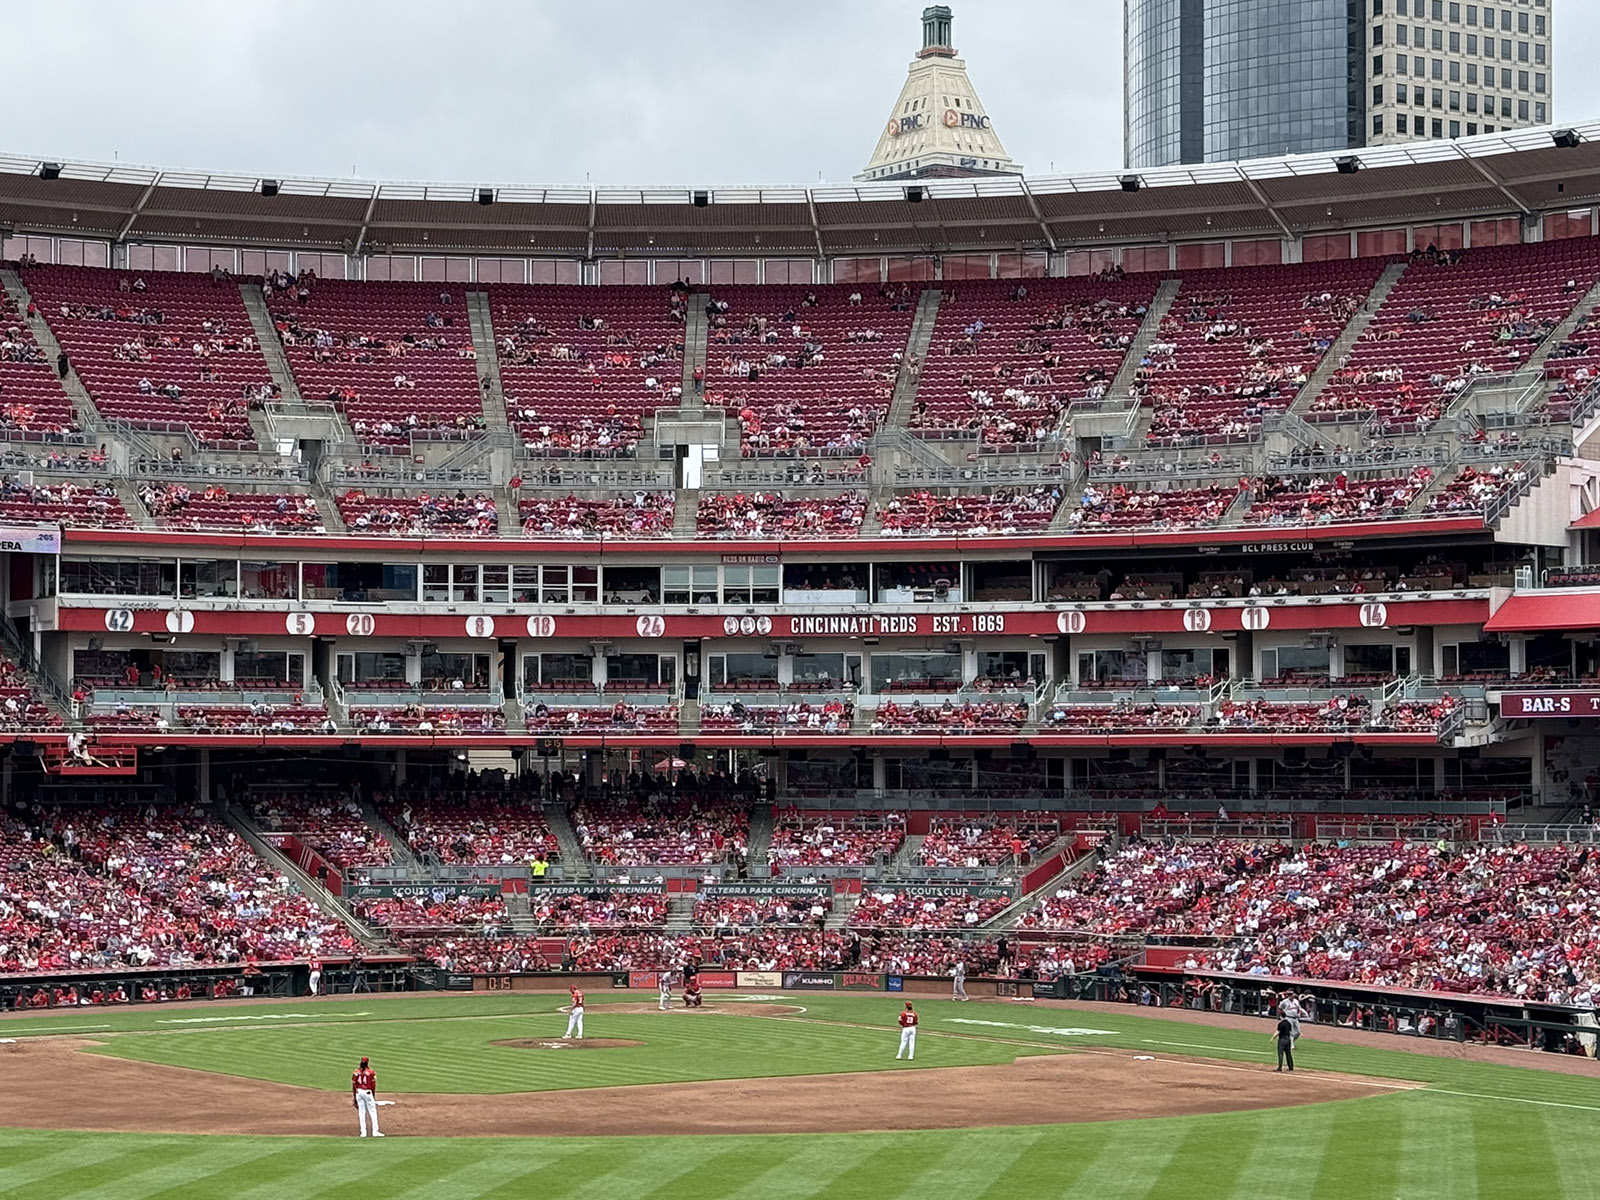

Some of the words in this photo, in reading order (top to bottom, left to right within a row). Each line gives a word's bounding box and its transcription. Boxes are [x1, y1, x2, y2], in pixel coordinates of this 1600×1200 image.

[900, 113, 923, 132] PNC
[960, 112, 990, 129] PNC
[0, 541, 22, 551] ERA
[1242, 544, 1258, 553] BCL
[1261, 543, 1288, 552] PRESS
[1290, 542, 1314, 551] CLUB
[108, 610, 130, 631] 42
[295, 613, 306, 634] 5
[790, 617, 874, 633] CINCINNATI
[880, 616, 917, 633] REDS
[932, 615, 967, 632] EST.
[972, 615, 1004, 632] 1869
[1062, 612, 1081, 632] 10
[1187, 609, 1206, 630] 13
[1246, 608, 1263, 629] 11
[1363, 604, 1382, 625] 14
[350, 615, 372, 635] 20
[475, 617, 485, 636] 8
[533, 616, 550, 636] 18
[641, 616, 662, 636] 24
[1521, 697, 1571, 712] BAR-S
[905, 887, 943, 896] SCOUTS
[802, 977, 834, 985] KUMHO
